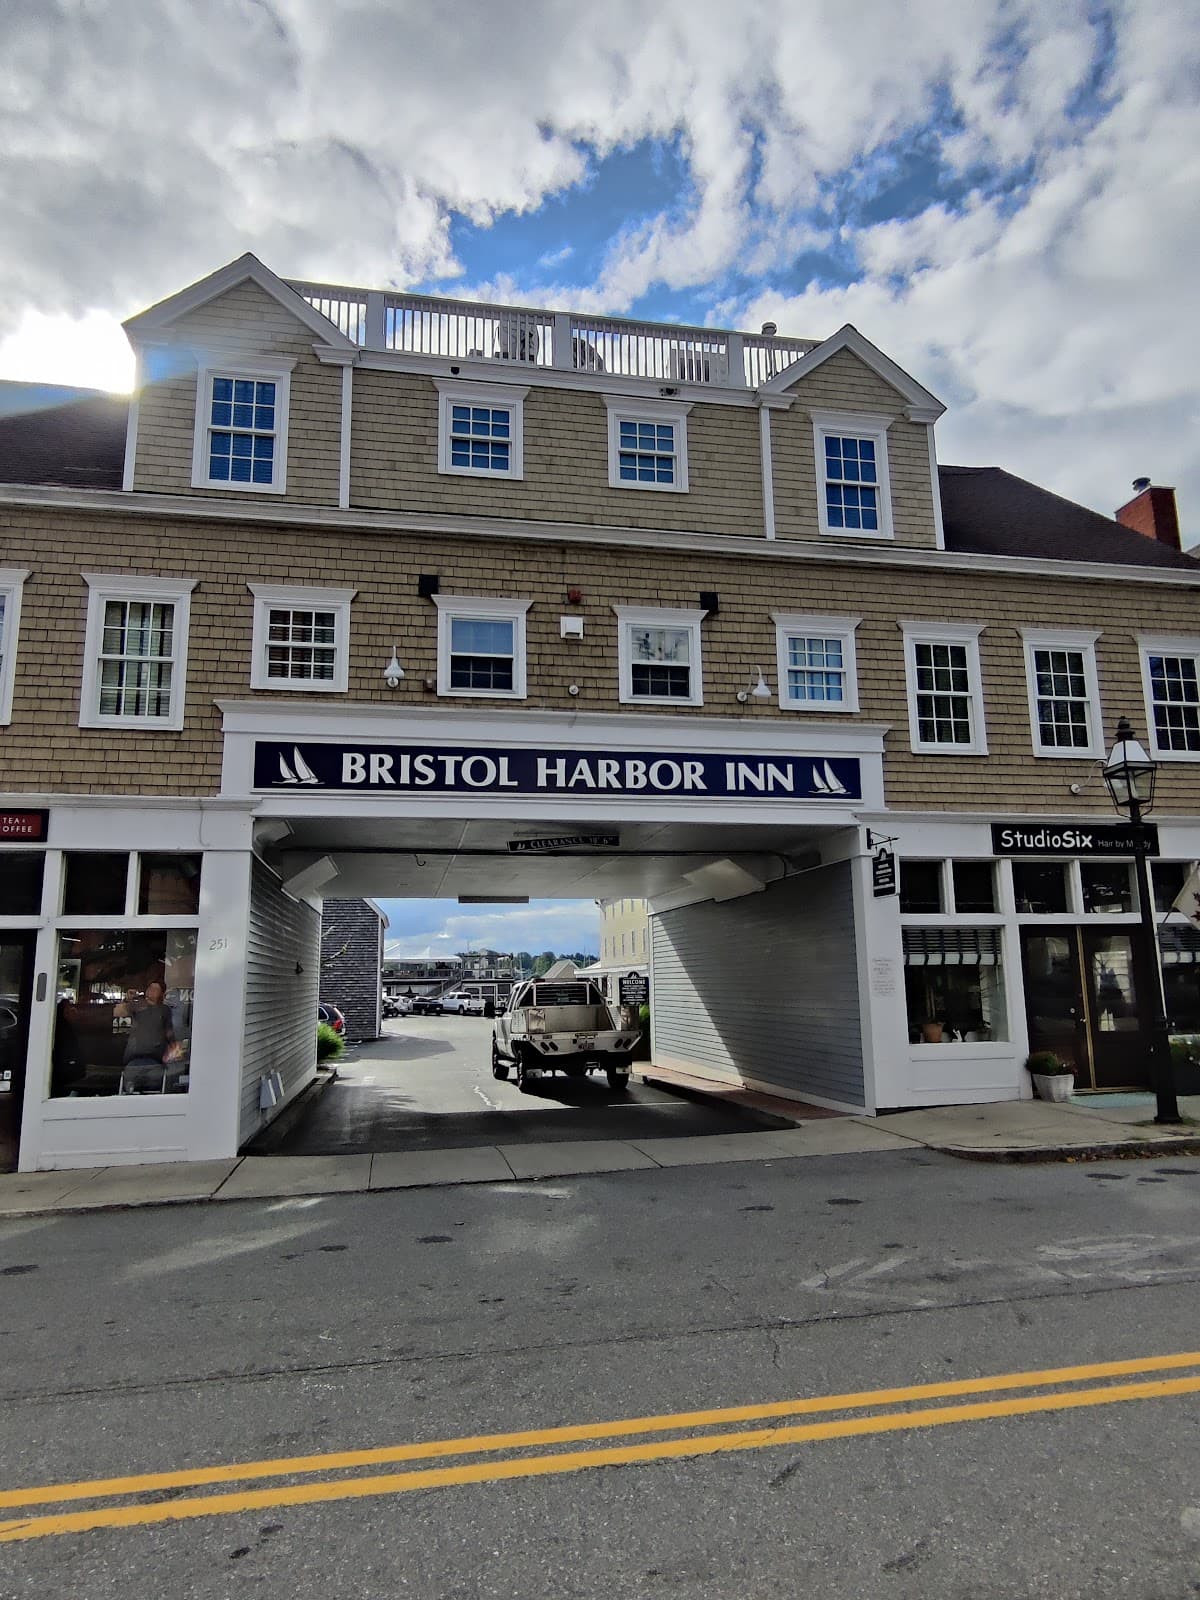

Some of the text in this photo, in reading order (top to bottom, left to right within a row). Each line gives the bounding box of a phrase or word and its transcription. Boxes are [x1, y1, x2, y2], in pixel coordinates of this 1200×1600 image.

[341, 752, 794, 792] BRISTOL HARBOR INN
[2, 825, 33, 833] OFFEE
[1001, 829, 1093, 848] StudioSix
[1097, 839, 1113, 848] Hair
[1115, 840, 1125, 849] by
[209, 938, 227, 951] 251
